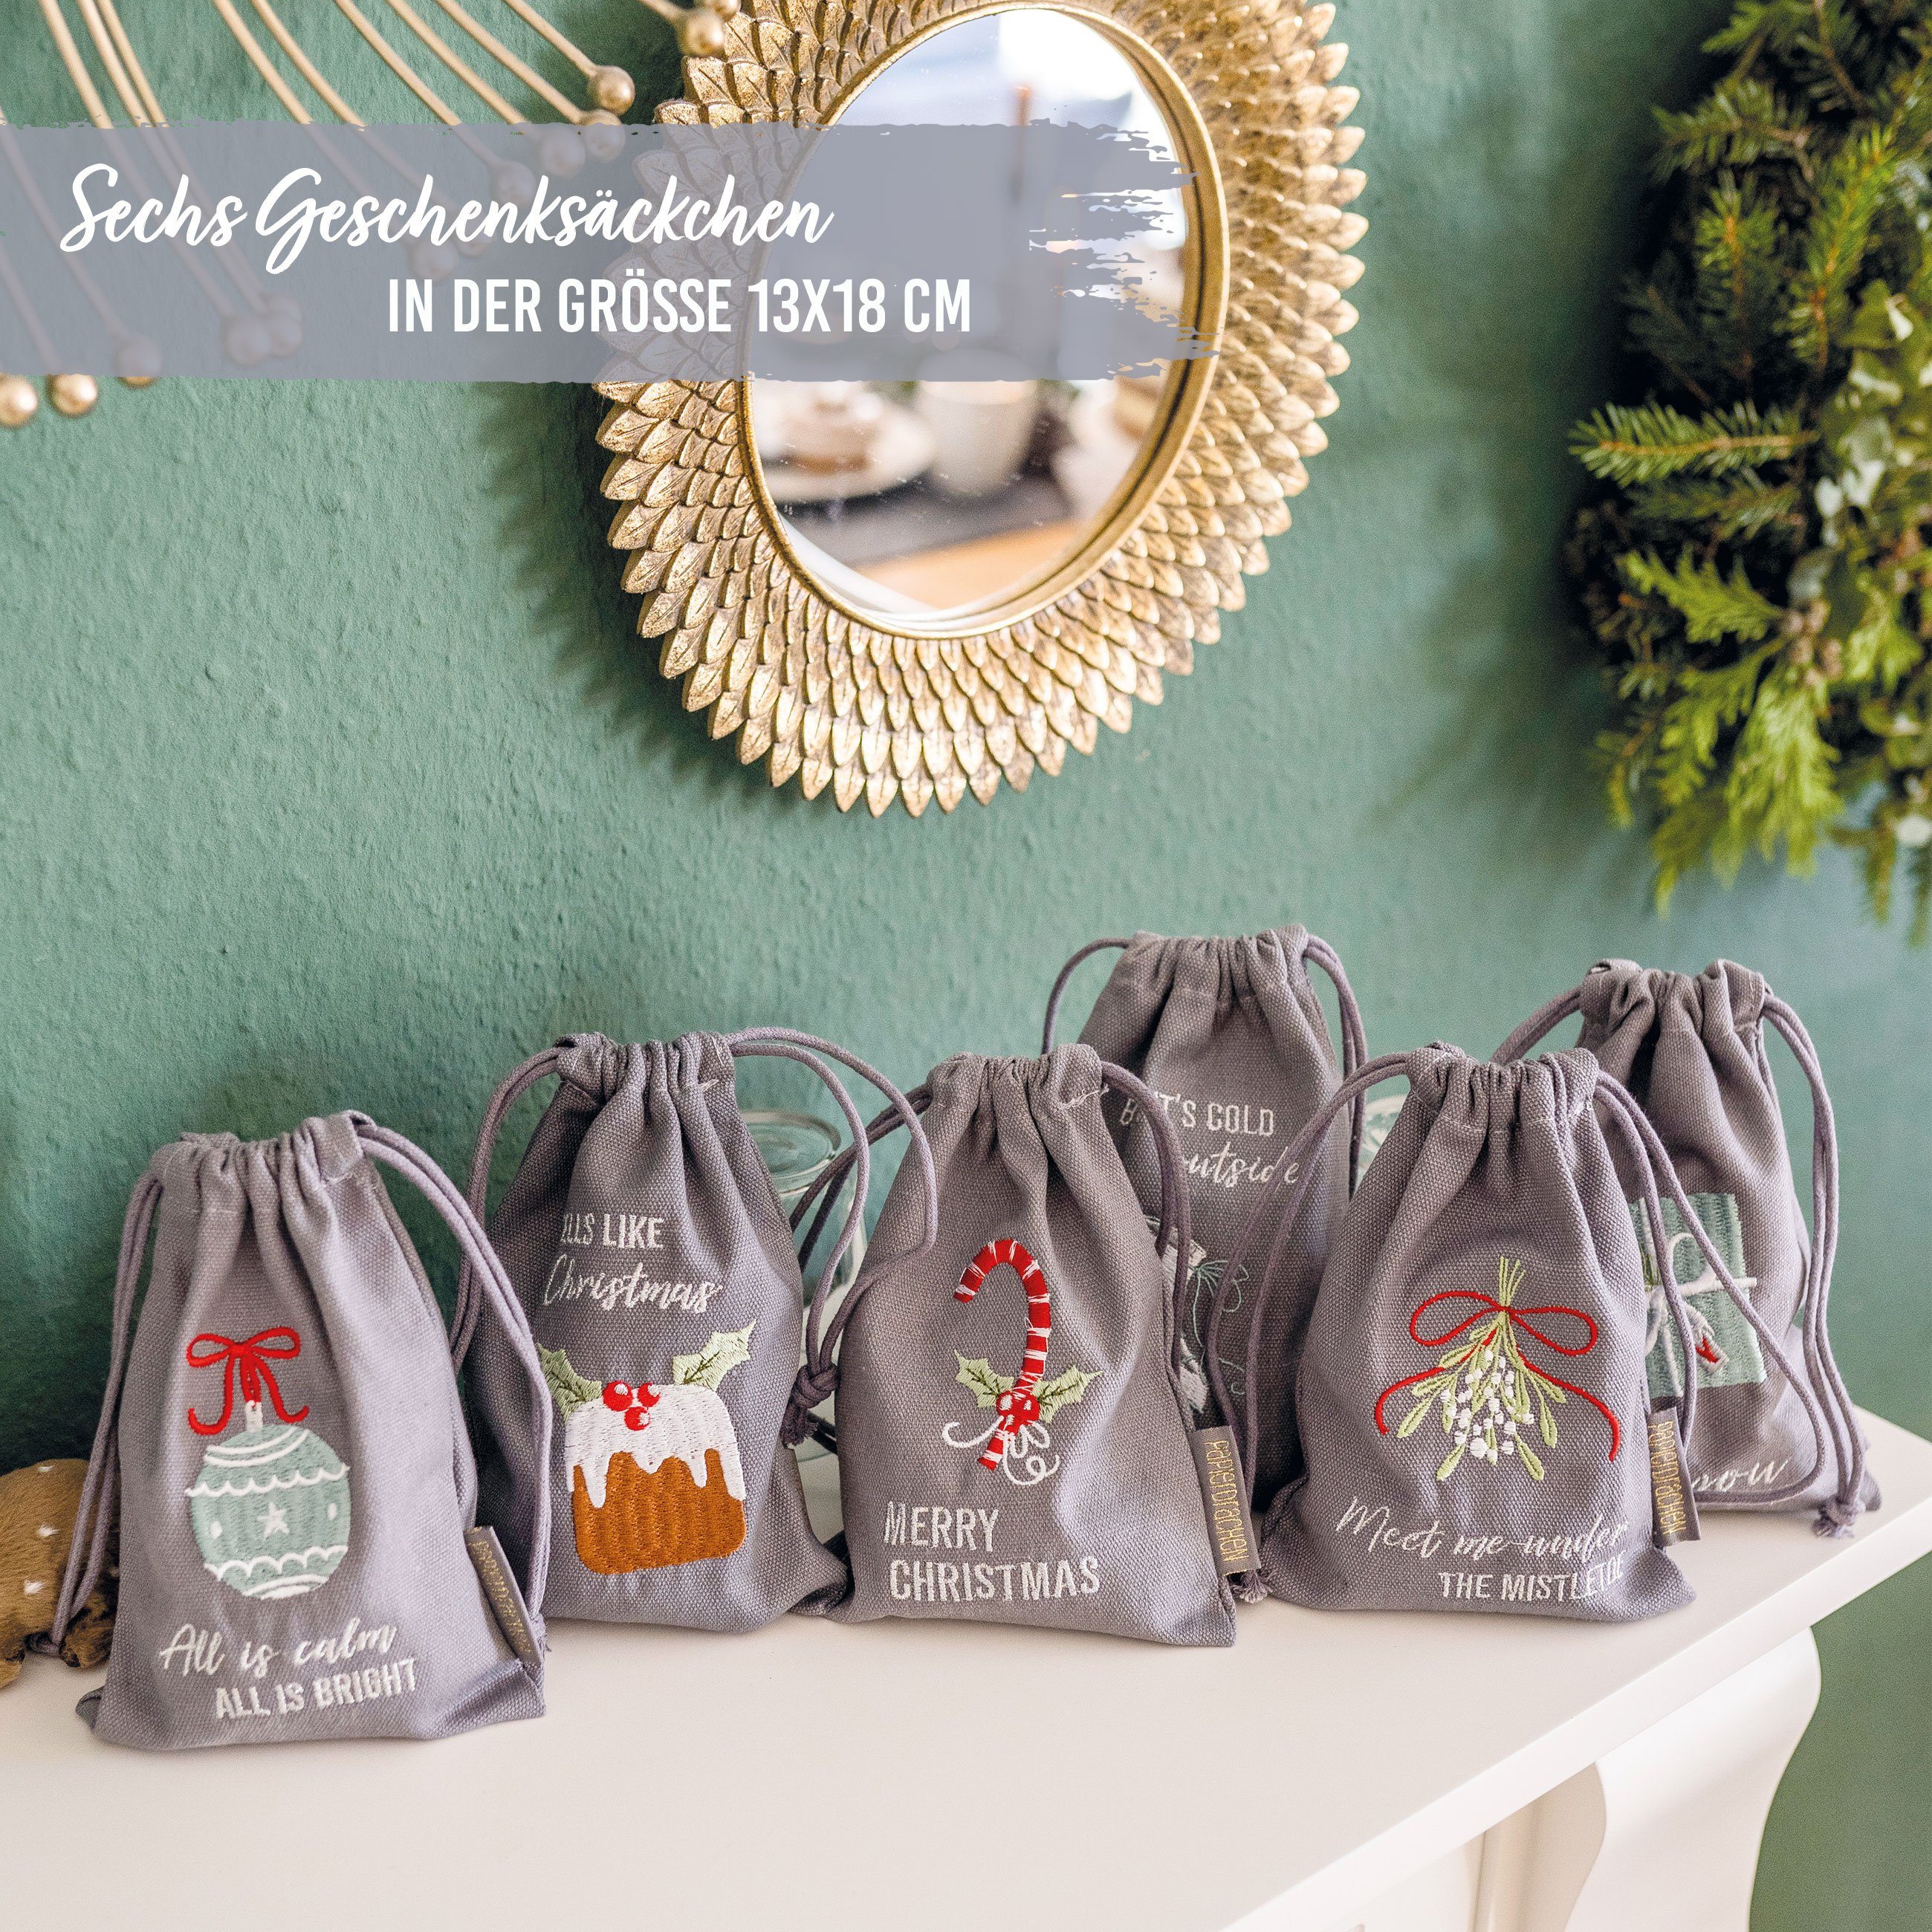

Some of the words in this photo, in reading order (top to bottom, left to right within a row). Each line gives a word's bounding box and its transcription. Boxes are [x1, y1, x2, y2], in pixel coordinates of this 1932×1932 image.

[1154, 1090, 1197, 1129] T'S
[1206, 1102, 1275, 1137] COLD
[1184, 1141, 1300, 1193] utside
[602, 1213, 665, 1249] LIKE
[542, 1253, 724, 1315] Christmas
[883, 1500, 1001, 1553] MERRY
[1335, 1495, 1447, 1559] Meet
[1453, 1534, 1511, 1561] me
[1520, 1514, 1630, 1563] under
[889, 1555, 1102, 1603] CHRISTMAS
[1437, 1571, 1494, 1601] THE
[158, 1623, 226, 1677] All
[238, 1639, 279, 1679] is
[294, 1615, 398, 1667] calm
[214, 1686, 272, 1720] ALL
[275, 1680, 305, 1715] IS
[312, 1656, 418, 1711] BRIGHT
